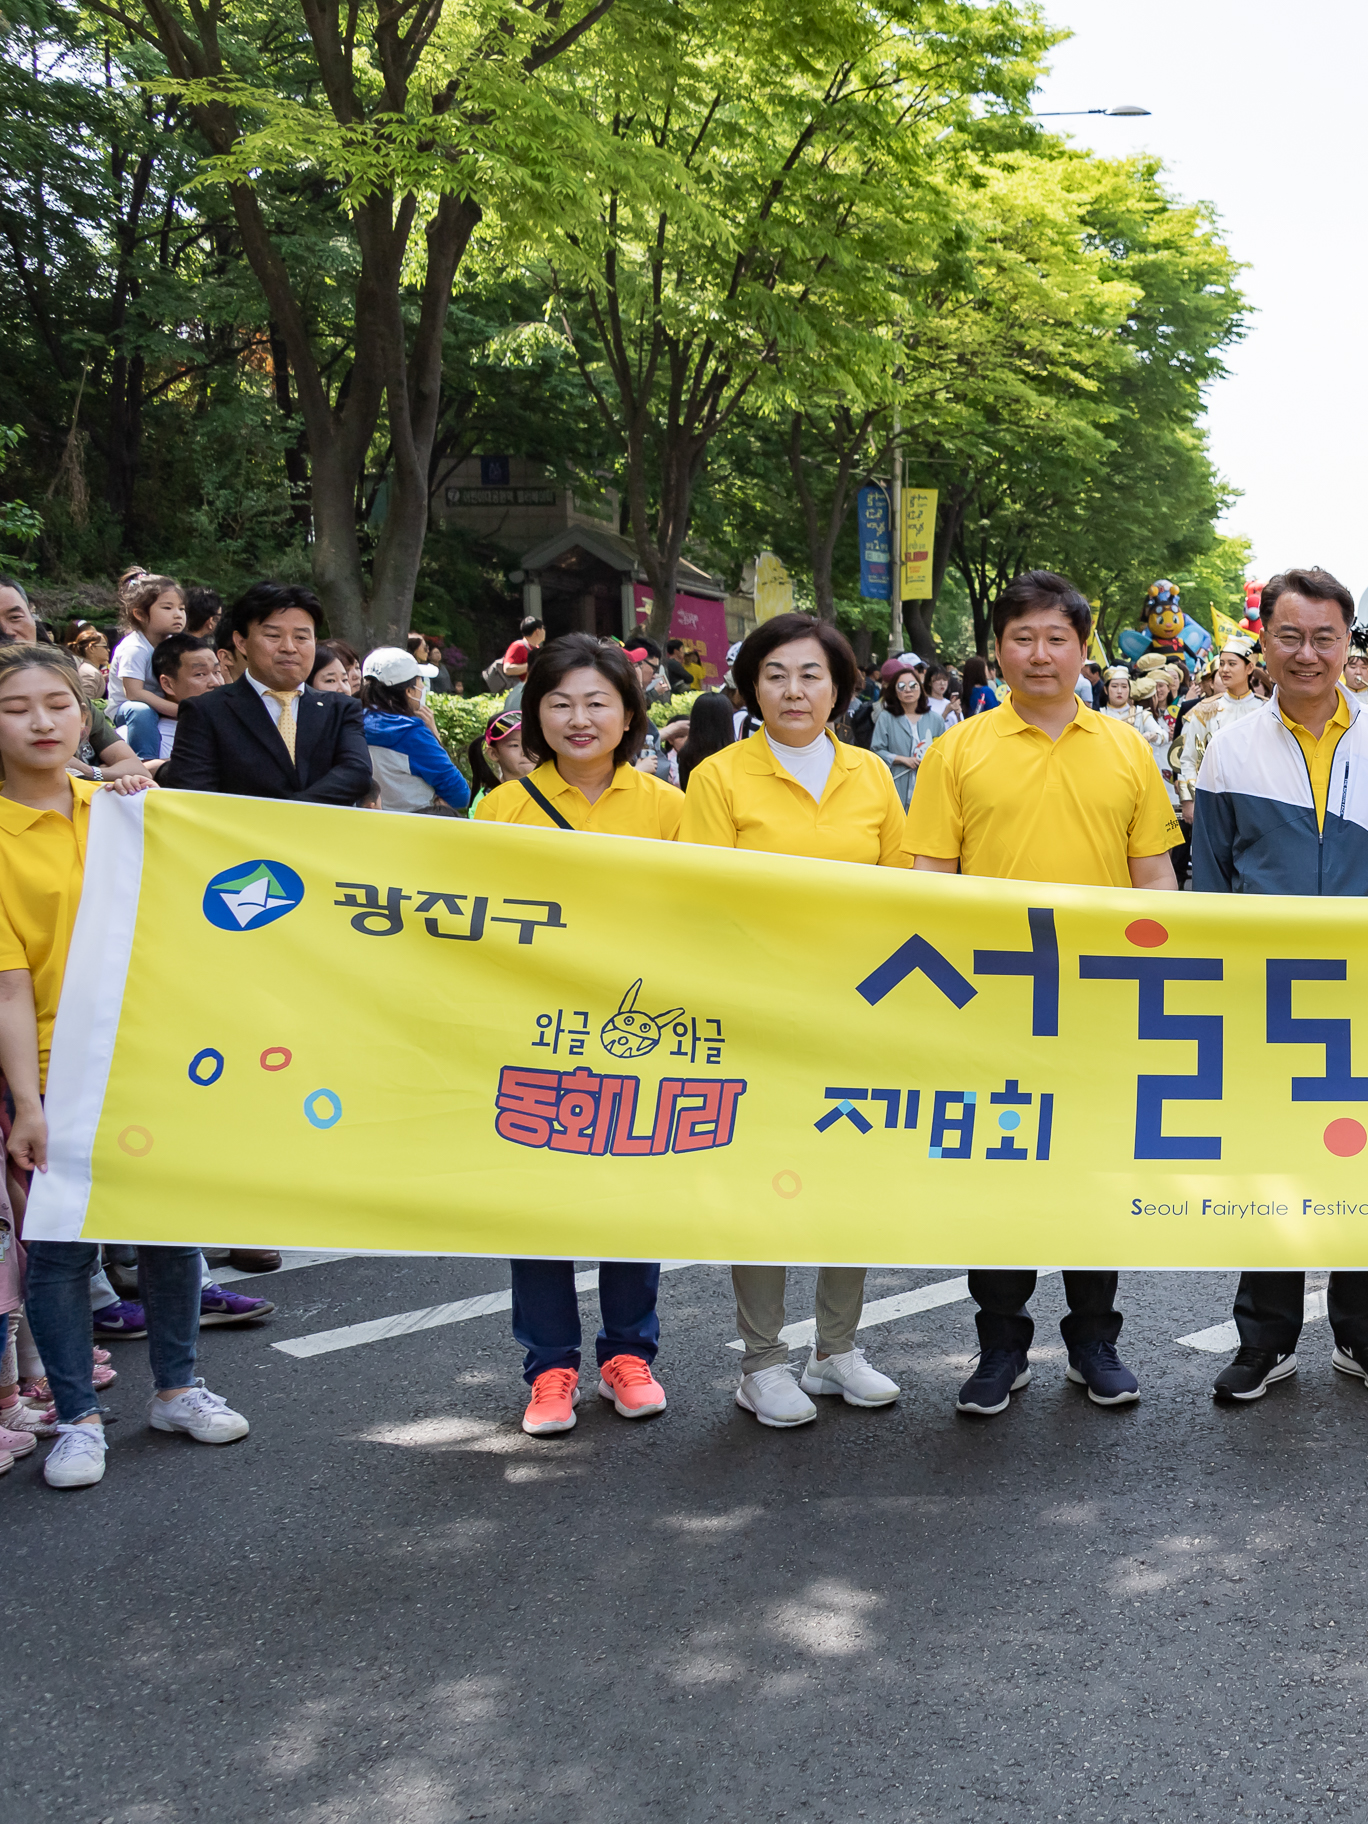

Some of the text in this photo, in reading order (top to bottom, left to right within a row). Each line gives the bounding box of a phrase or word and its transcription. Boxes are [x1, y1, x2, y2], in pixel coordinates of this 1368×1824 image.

[334, 882, 567, 945] 광진구
[531, 1009, 726, 1065] 와글 와글
[495, 1065, 747, 1157] 동화나라
[813, 1079, 1054, 1161] 제8회
[1131, 1198, 1188, 1216] Seoul
[1202, 1198, 1289, 1219] Fairytale
